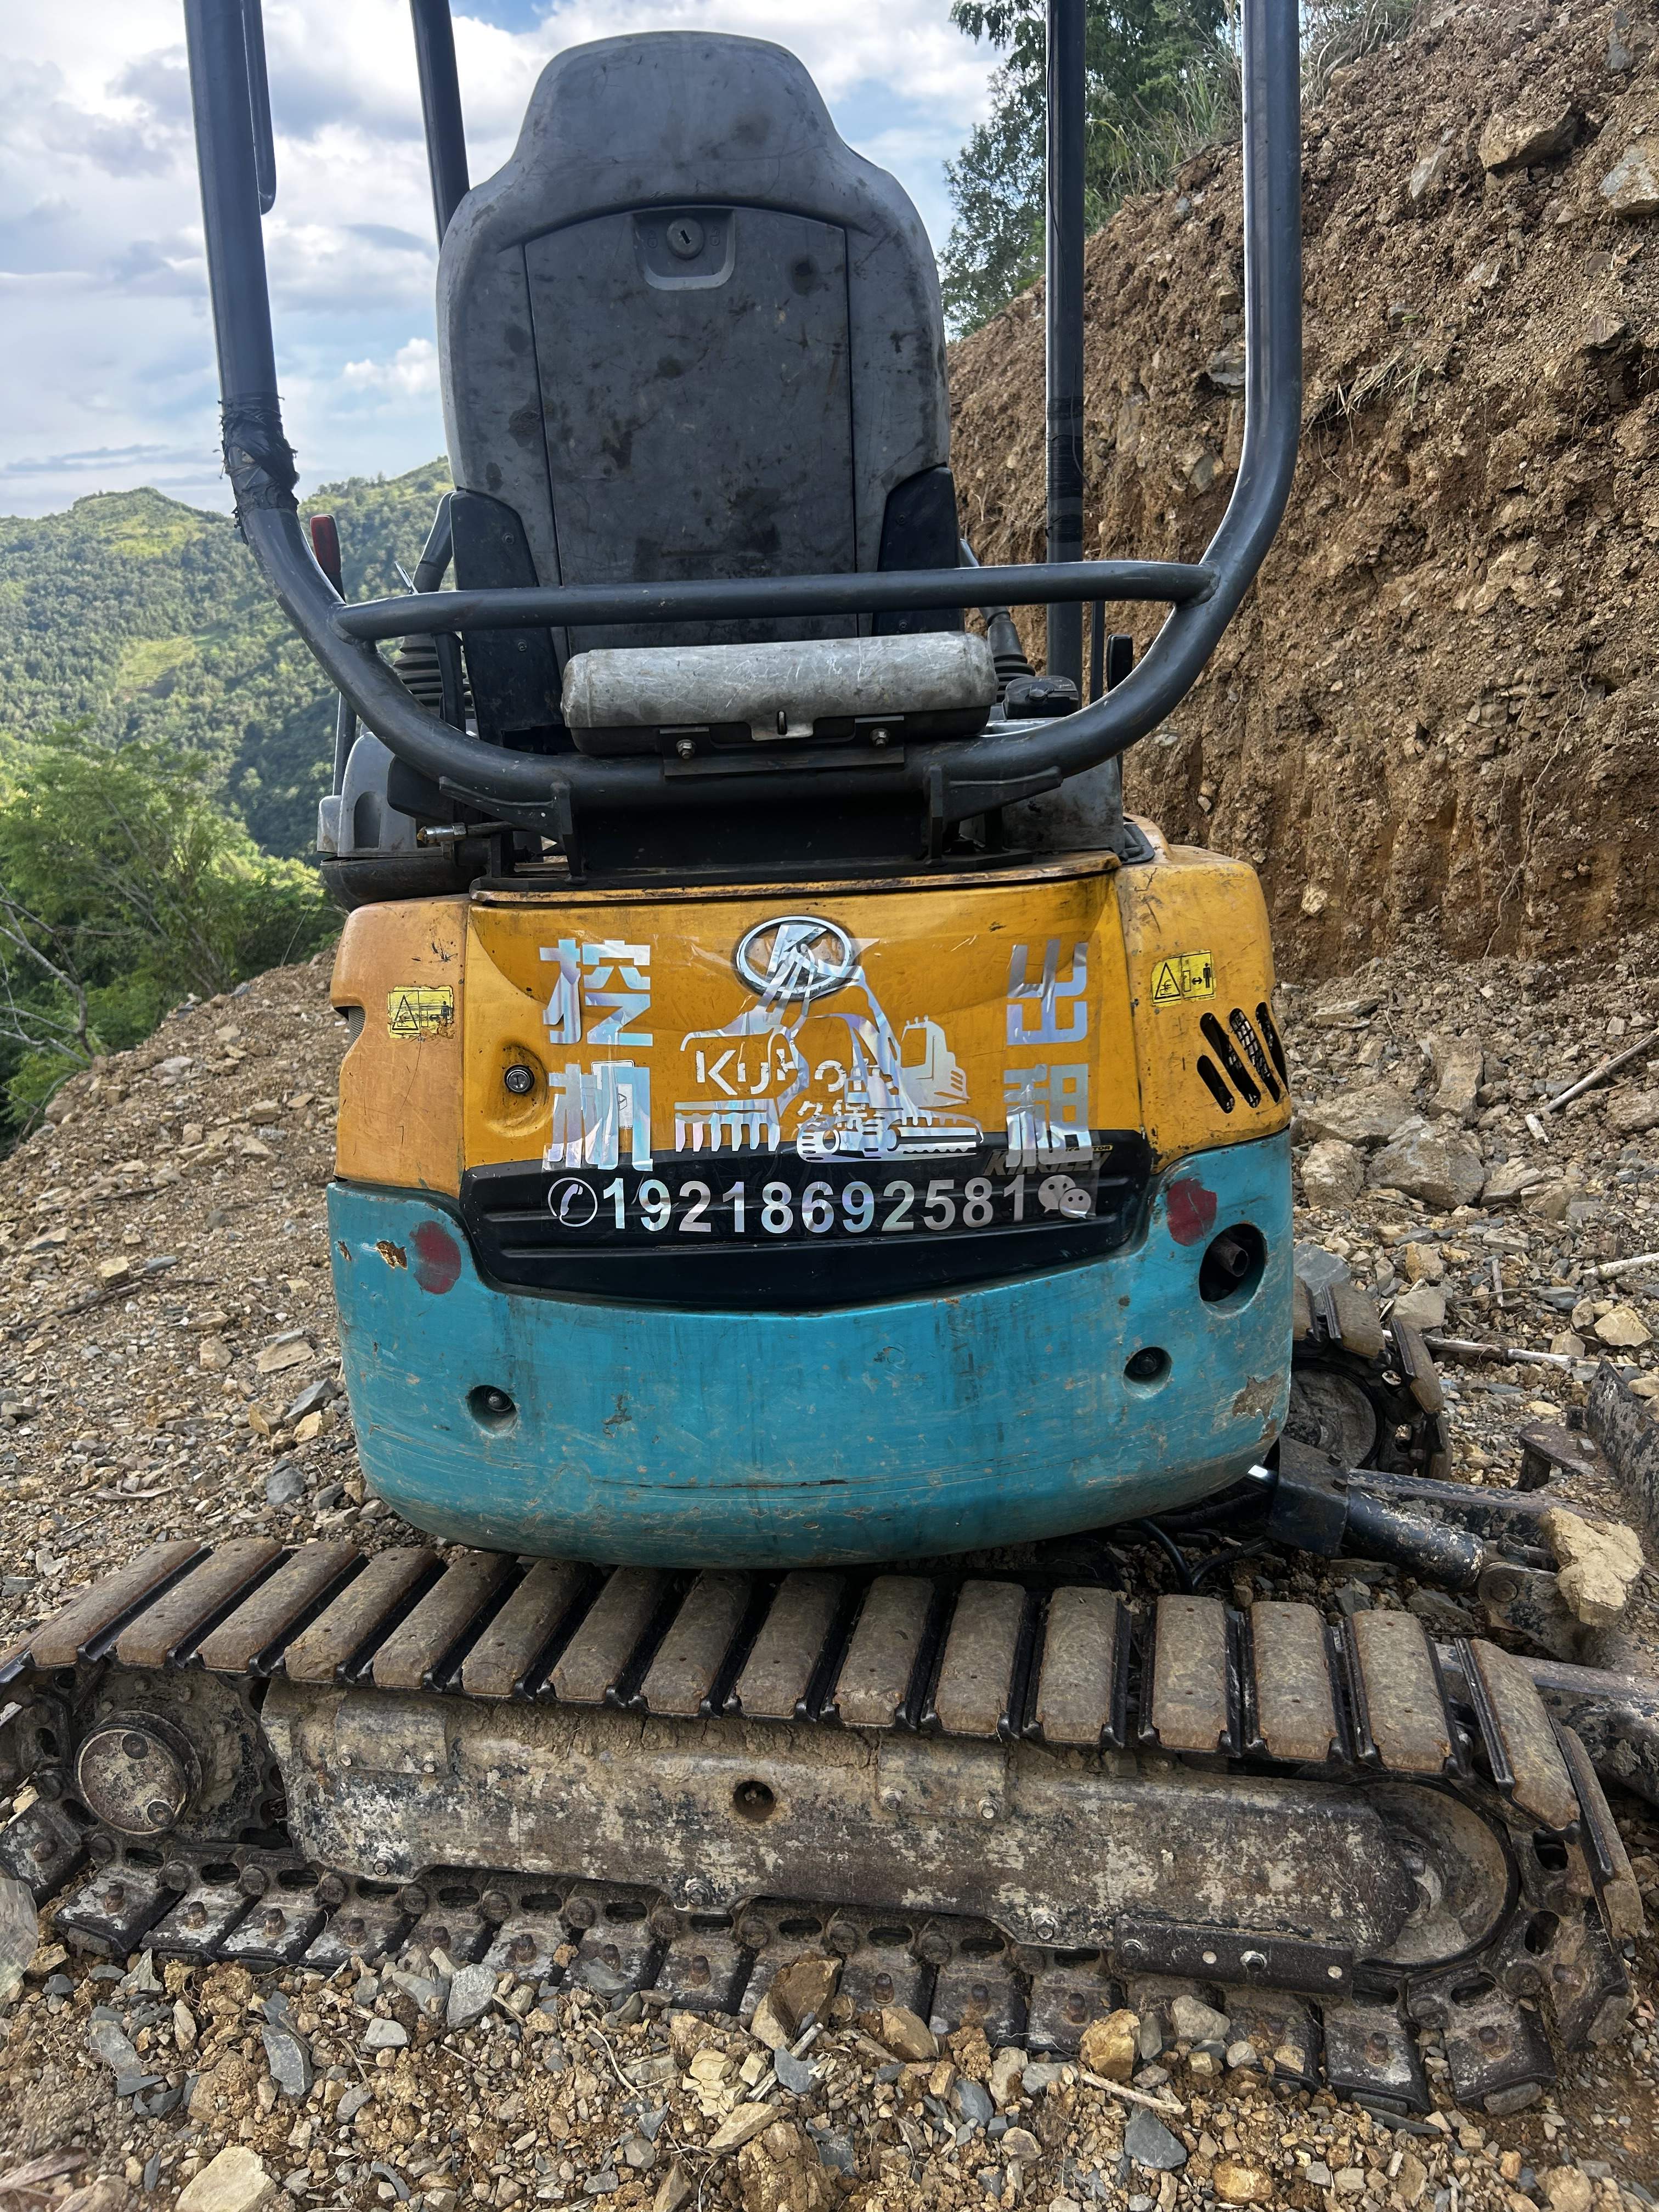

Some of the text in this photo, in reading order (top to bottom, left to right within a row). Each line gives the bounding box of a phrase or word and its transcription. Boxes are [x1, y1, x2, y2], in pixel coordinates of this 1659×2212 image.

[540, 939, 653, 1171] 挖机
[1003, 939, 1093, 1168] 出租
[603, 1175, 1025, 1233] 19218692581
